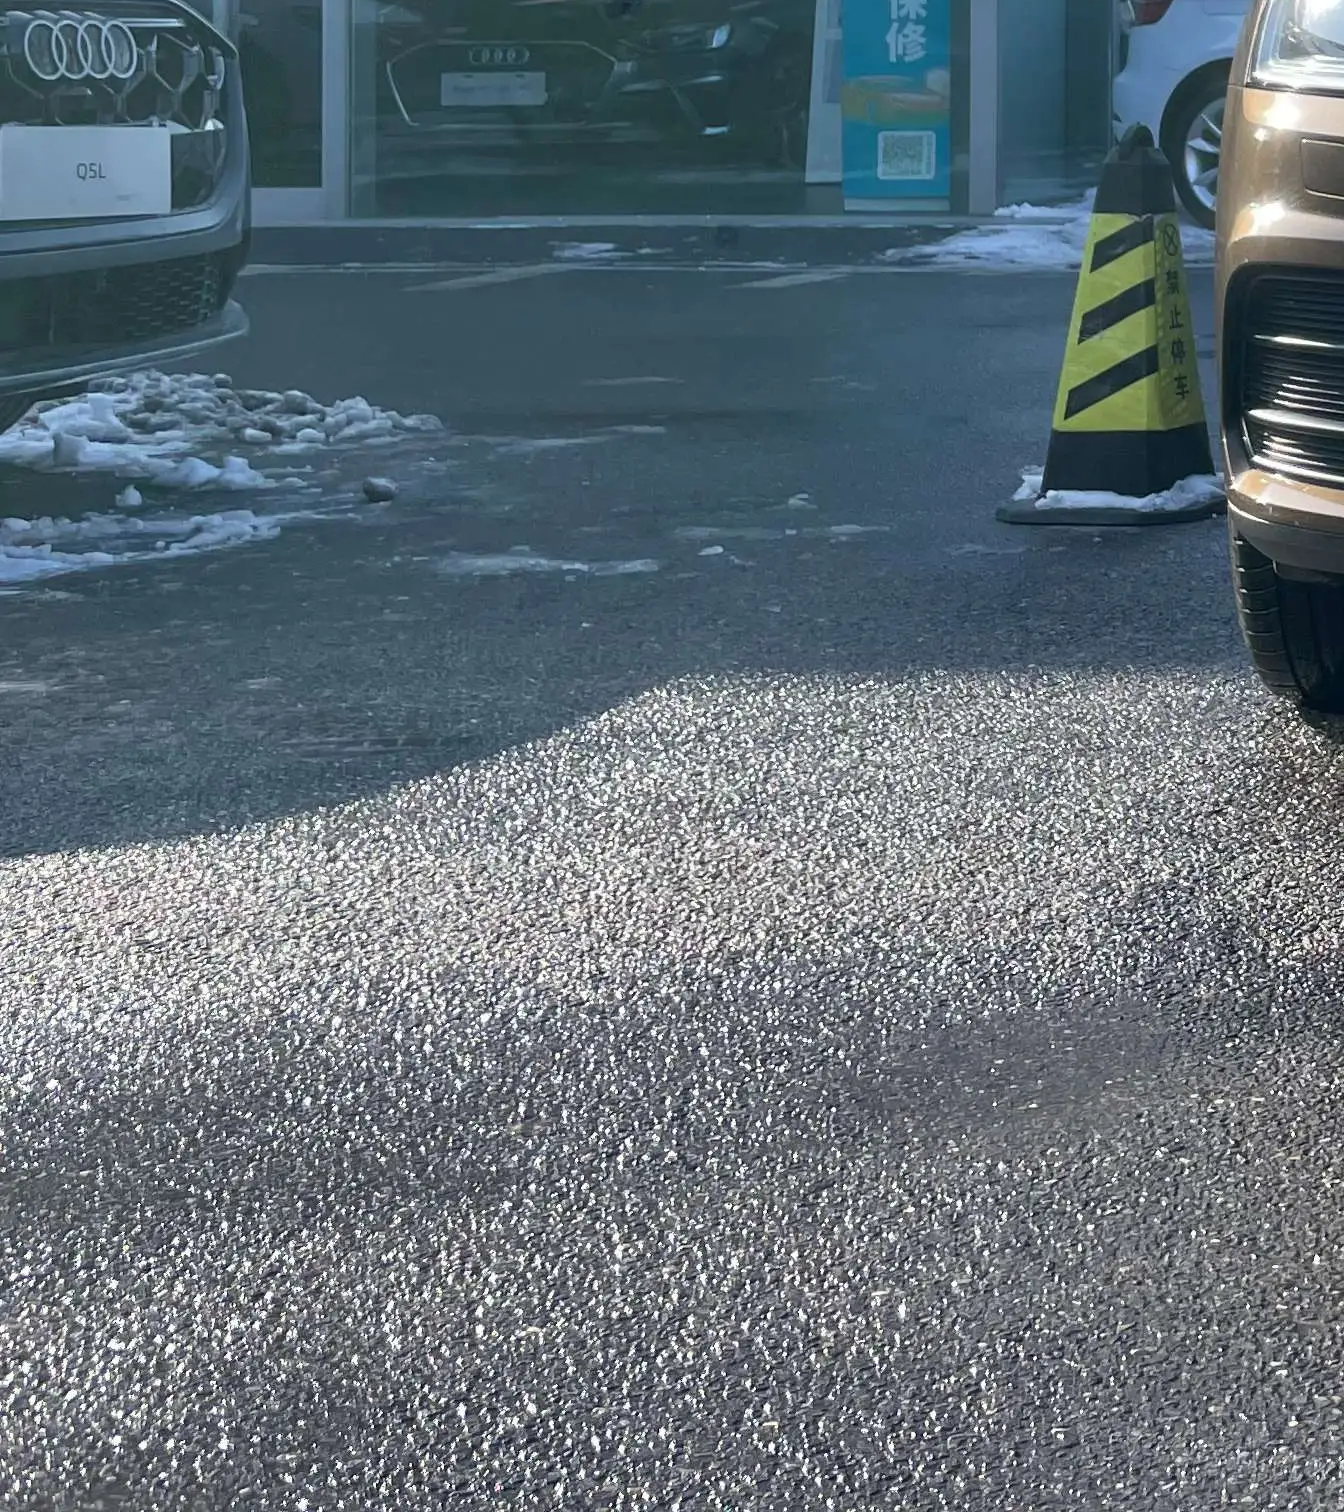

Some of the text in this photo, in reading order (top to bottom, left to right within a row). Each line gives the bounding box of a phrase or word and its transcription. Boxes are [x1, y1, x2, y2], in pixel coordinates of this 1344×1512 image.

[76, 162, 107, 181] Q5L
[1165, 269, 1190, 401] 禁止停车
